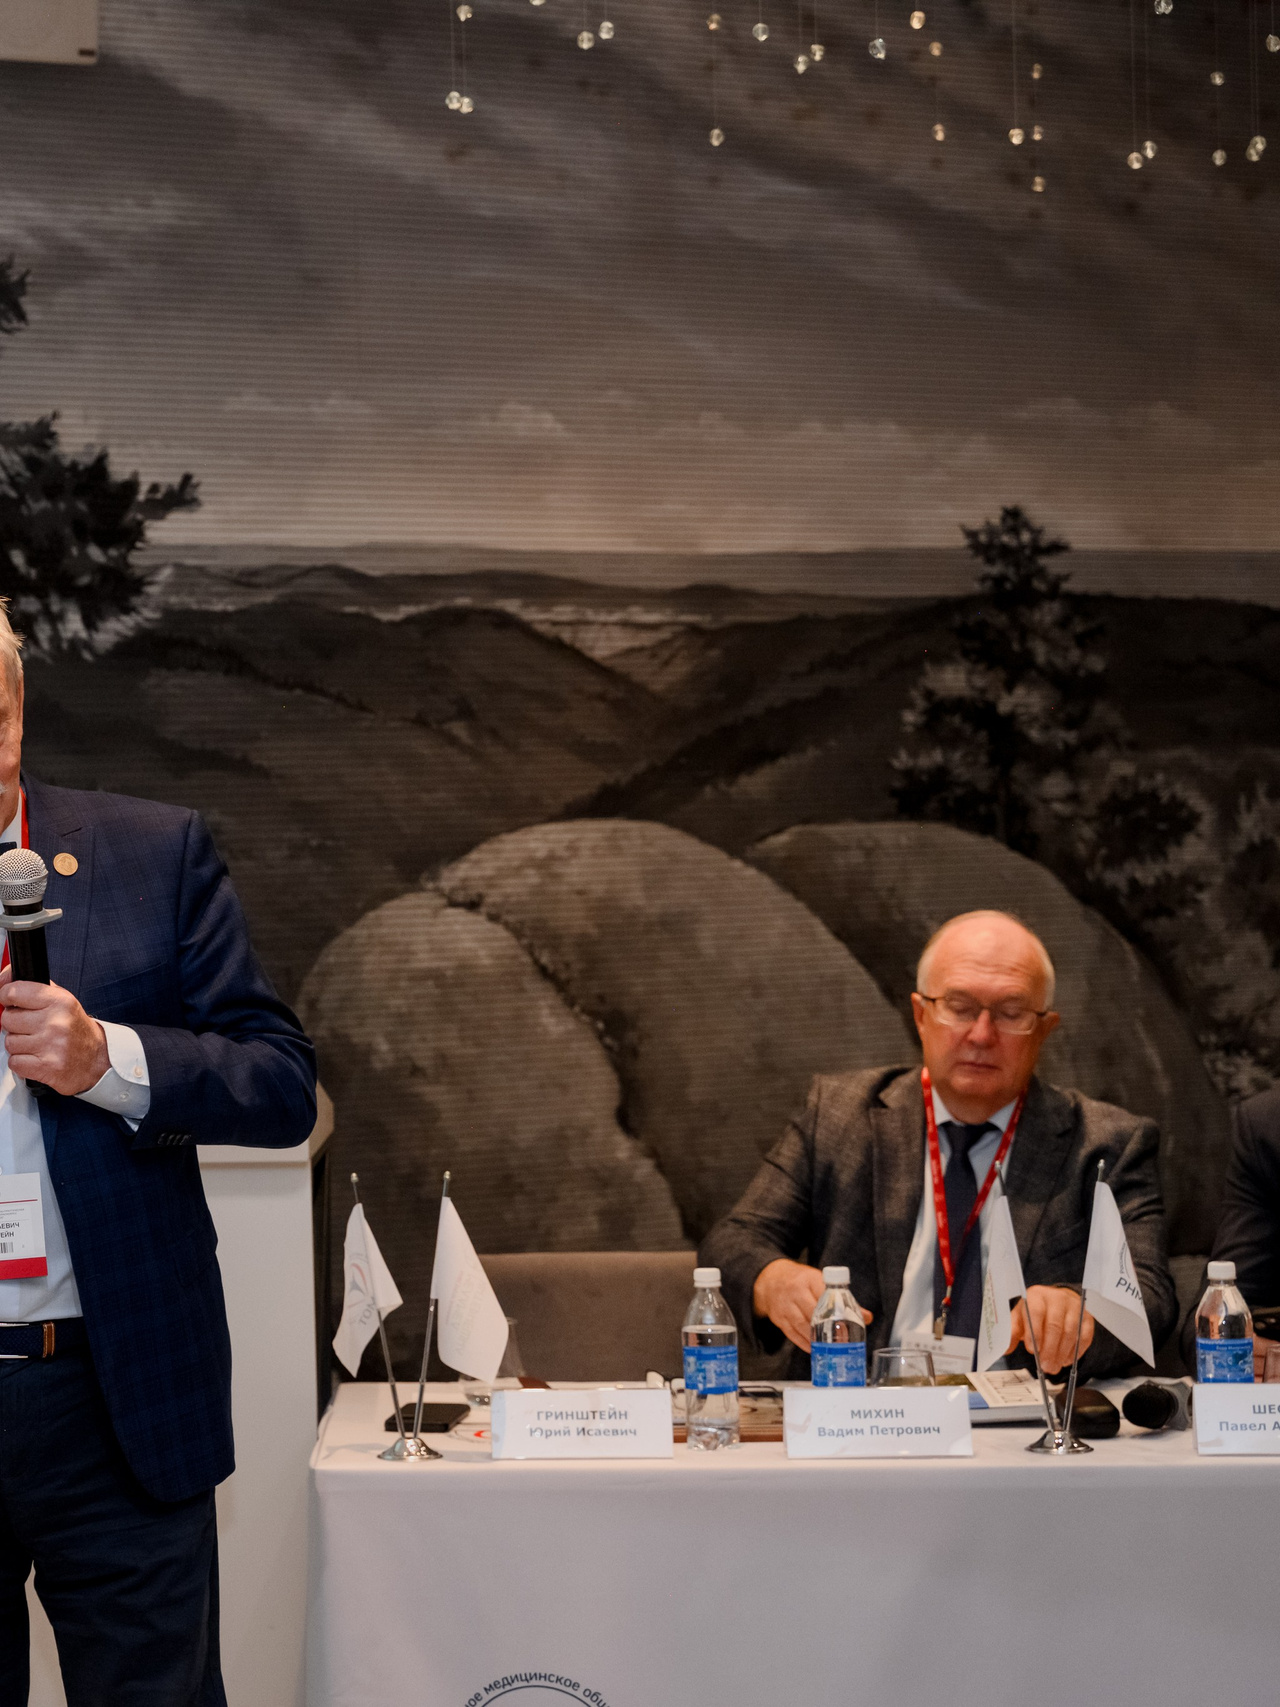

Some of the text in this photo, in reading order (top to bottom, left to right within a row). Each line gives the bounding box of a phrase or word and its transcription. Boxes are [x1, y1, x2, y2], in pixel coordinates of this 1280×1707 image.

[536, 1407, 628, 1420] ГРИНШТЕЙН
[850, 1408, 905, 1419] МИХИН
[1252, 1404, 1280, 1415] ШЕ
[529, 1426, 637, 1439] Юрий Исаевич
[817, 1425, 941, 1438] Вадим Петрович
[1219, 1421, 1267, 1432] Павел
[483, 1672, 580, 1695] медицинское
